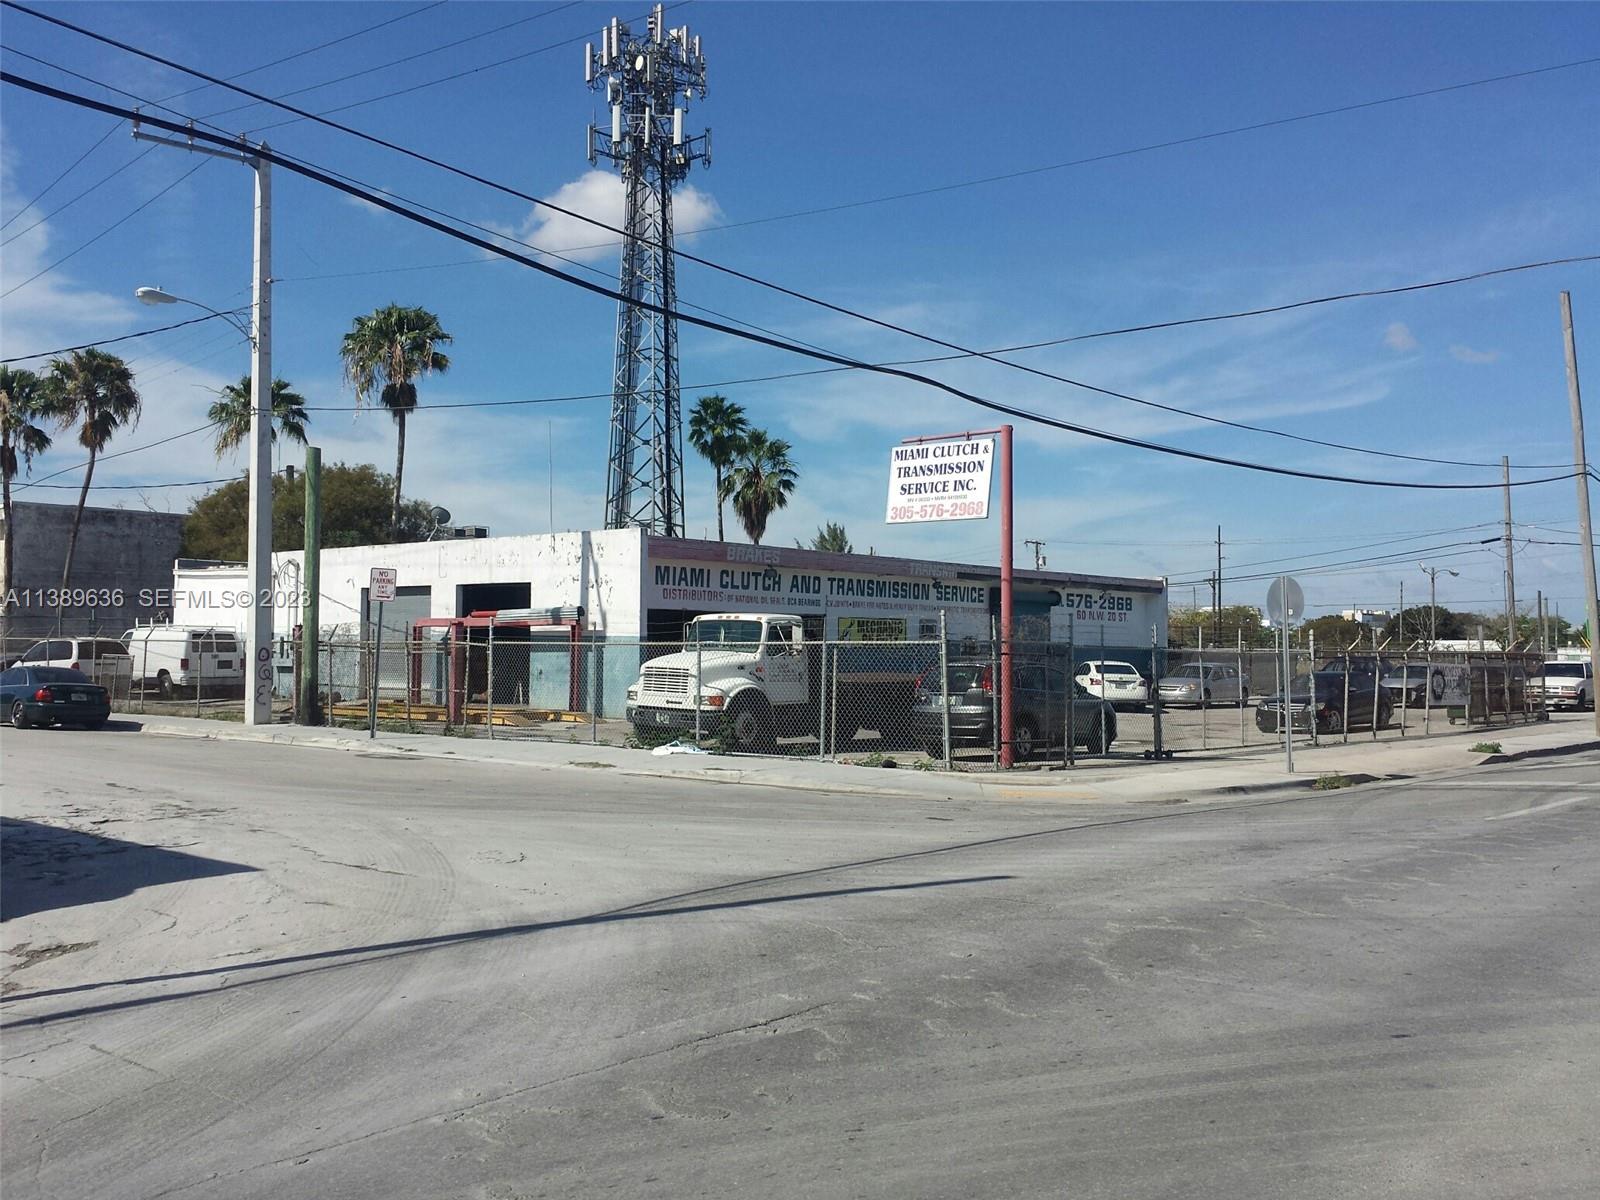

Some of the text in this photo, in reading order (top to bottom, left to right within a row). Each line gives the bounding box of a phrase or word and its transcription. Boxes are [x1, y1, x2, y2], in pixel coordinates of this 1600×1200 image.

[894, 443, 990, 461] MIAMI CLUTCH &
[897, 460, 985, 478] TRANSMISSION
[899, 478, 977, 496] SERVICE INC.
[890, 501, 984, 520] 305-576-2968
[726, 545, 780, 563] BRAKES
[372, 577, 394, 585] PARKING
[655, 565, 985, 603] MIAMI CLUTCH AND TRANSMISSION SERVICE
[1066, 593, 1133, 611] 576-2968
[1076, 610, 1087, 620] 60
[1107, 612, 1117, 622] 20
[857, 619, 904, 634] MECHANIC
